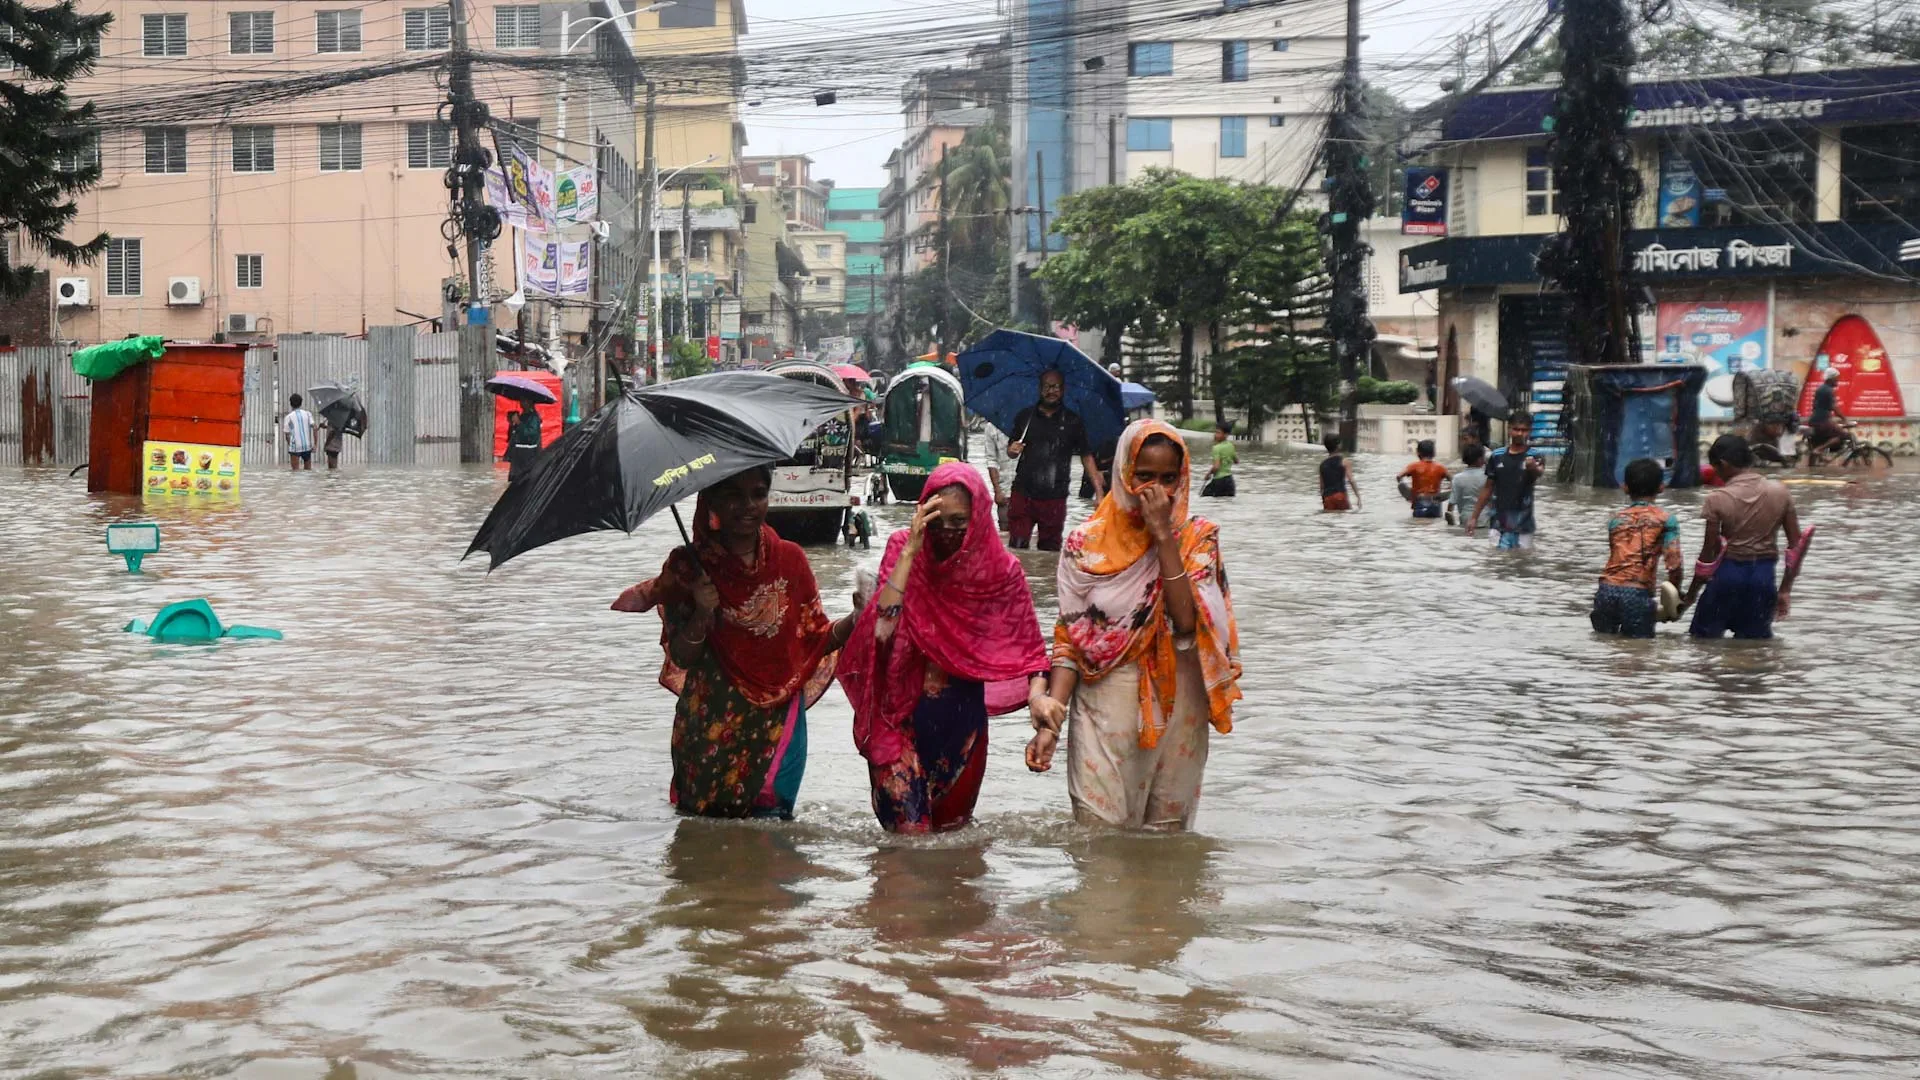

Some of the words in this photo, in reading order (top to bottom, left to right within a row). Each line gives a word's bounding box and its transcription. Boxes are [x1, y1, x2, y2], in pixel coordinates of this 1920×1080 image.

[1628, 99, 1735, 127] omino's
[1742, 96, 1825, 121] Pizza
[688, 453, 717, 470] ছাতা
